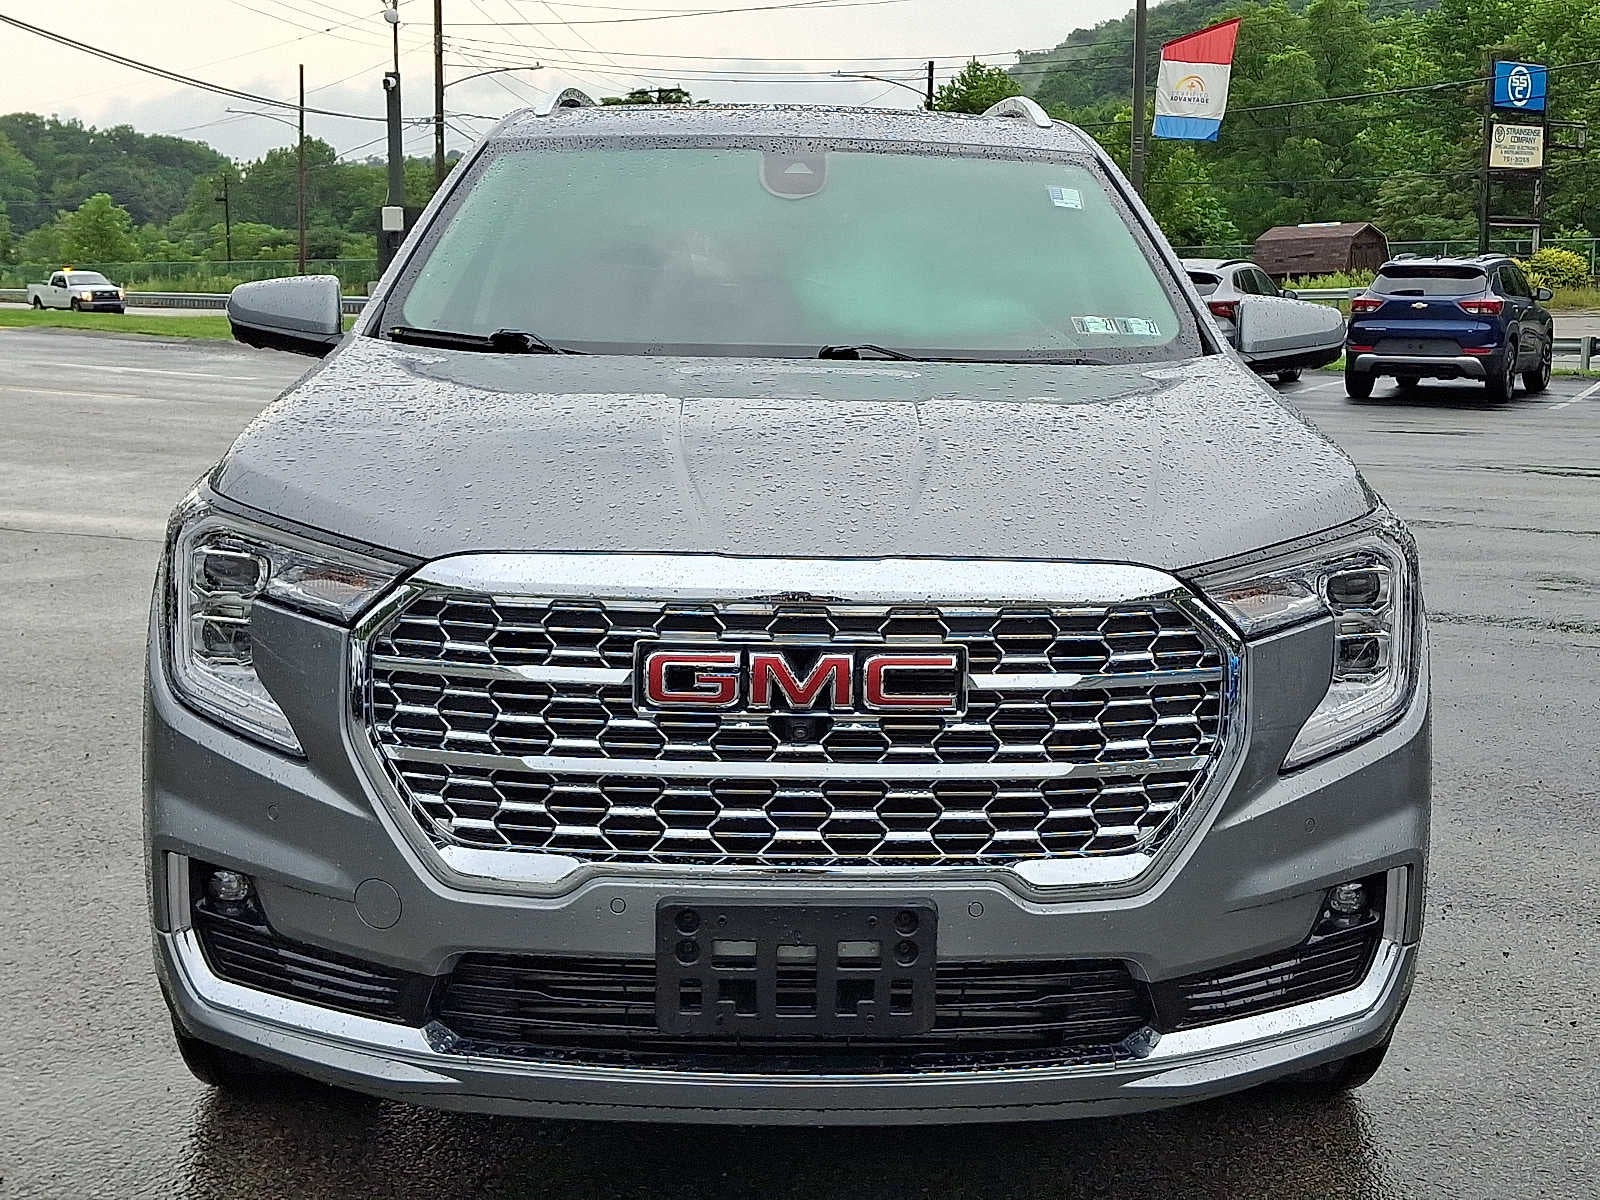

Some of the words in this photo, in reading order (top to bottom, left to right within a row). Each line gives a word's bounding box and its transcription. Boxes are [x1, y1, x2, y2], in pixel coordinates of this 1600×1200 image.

[1170, 96, 1209, 104] ADVANTAGE
[1510, 135, 1537, 144] COMPANY
[645, 650, 960, 712] GMC
